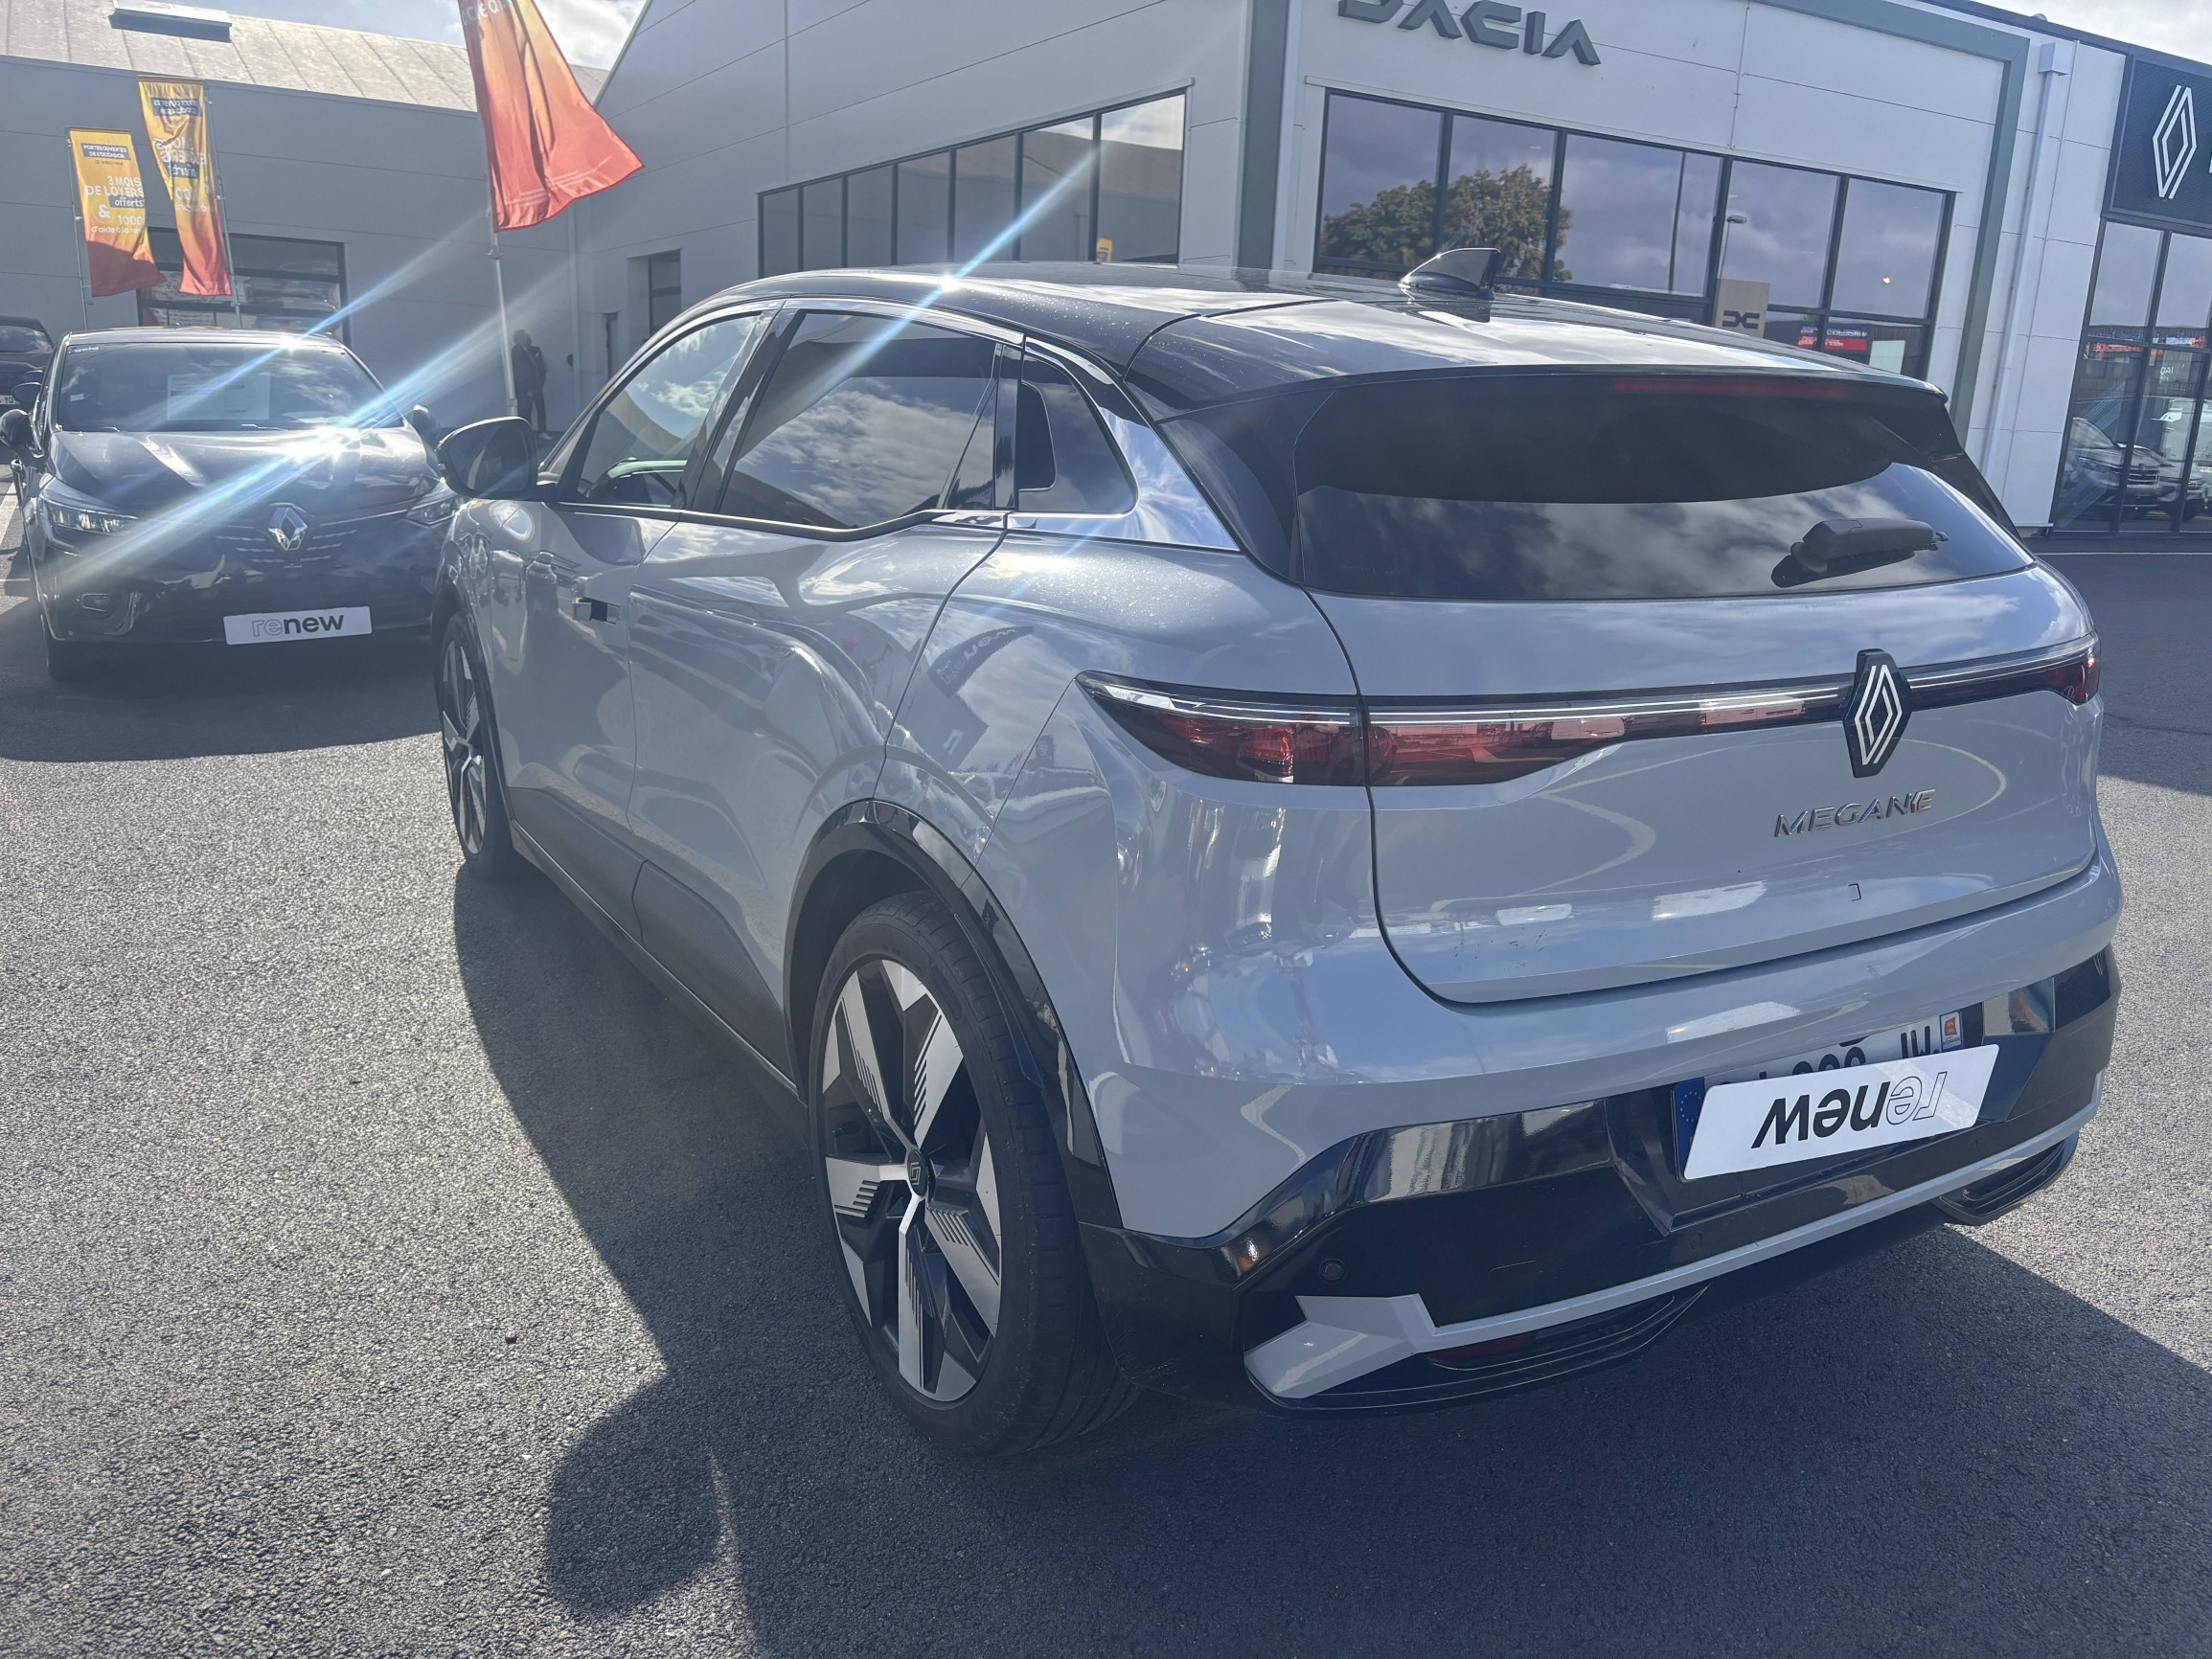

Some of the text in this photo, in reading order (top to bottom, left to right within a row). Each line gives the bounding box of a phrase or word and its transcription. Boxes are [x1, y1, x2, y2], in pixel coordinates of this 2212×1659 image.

[107, 175, 142, 187] 3 MOIS
[85, 185, 145, 198] DE LOYERS
[99, 204, 111, 218] &
[251, 614, 345, 637] renew
[1773, 788, 1936, 838] MEGANE
[1750, 1070, 1949, 1149] renew
